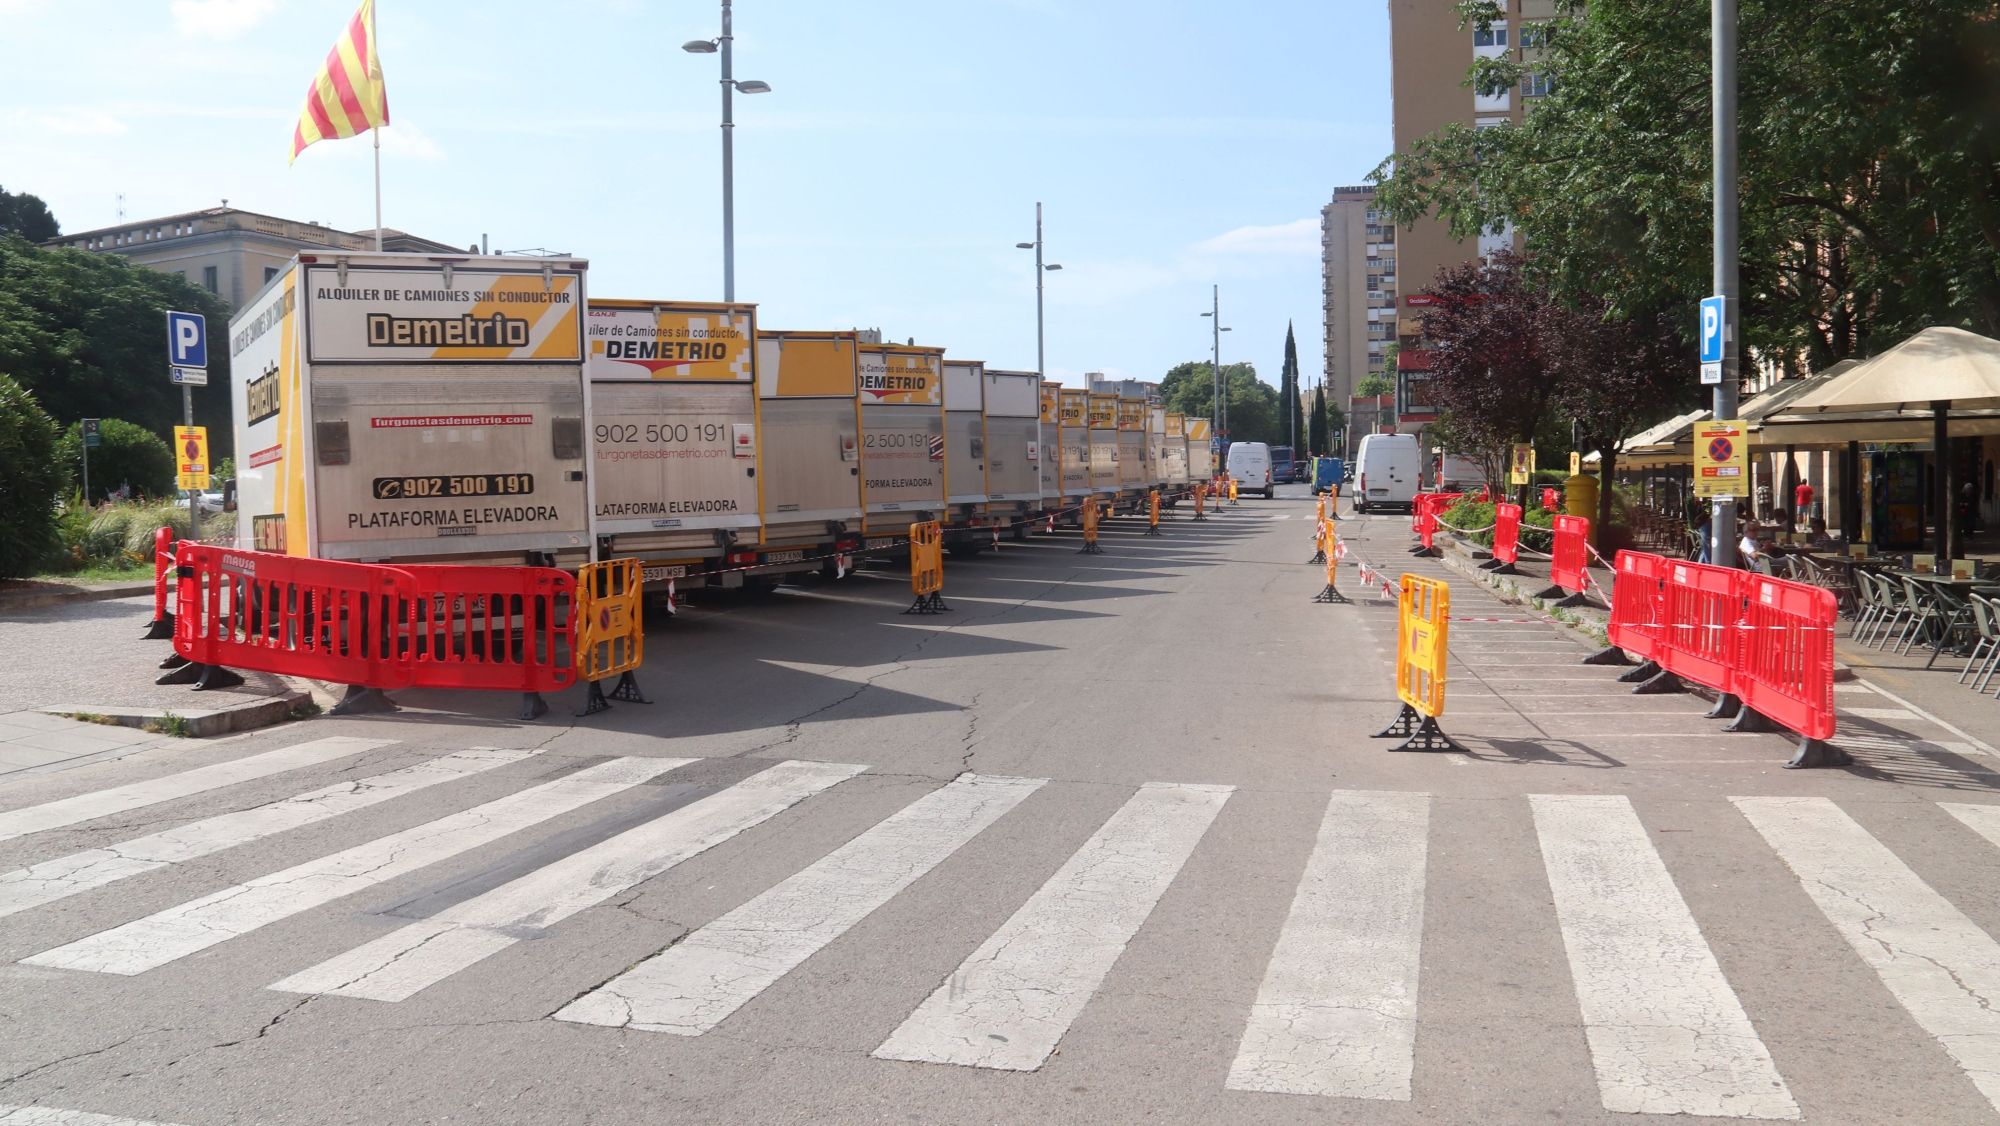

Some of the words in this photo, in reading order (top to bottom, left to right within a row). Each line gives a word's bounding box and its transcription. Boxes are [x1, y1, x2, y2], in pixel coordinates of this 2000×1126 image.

[318, 288, 380, 300] ALQUILER
[384, 289, 401, 301] DE
[404, 289, 469, 301] CAMIONES
[474, 291, 494, 302] SIN
[498, 291, 570, 303] CONDUCTOR
[367, 312, 529, 347] Demetrio
[611, 325, 623, 336] de
[626, 325, 673, 338] Camiones
[676, 326, 690, 338] sin
[693, 327, 739, 339] conductor
[1703, 305, 1718, 355] P
[175, 318, 199, 360] P
[606, 340, 727, 360] DEMETRIO
[867, 364, 894, 373] Camiones
[375, 416, 533, 428] furgonetasdemetrio.com
[595, 424, 638, 443] 902
[646, 424, 688, 442] 500
[694, 424, 726, 442] 191
[880, 434, 905, 448] 500
[909, 434, 928, 448] 191
[597, 448, 727, 462] furgonetasdemetrio.com
[404, 478, 442, 496] 902
[450, 476, 487, 495] 500
[496, 475, 529, 493] 191
[866, 480, 890, 489] FORMA
[892, 479, 932, 488] ELEVADORA
[670, 500, 737, 513] ELEVADORA
[348, 509, 459, 528] PLATAFORMA
[464, 506, 559, 524] ELEVADORA
[222, 554, 256, 571] MAUSA
